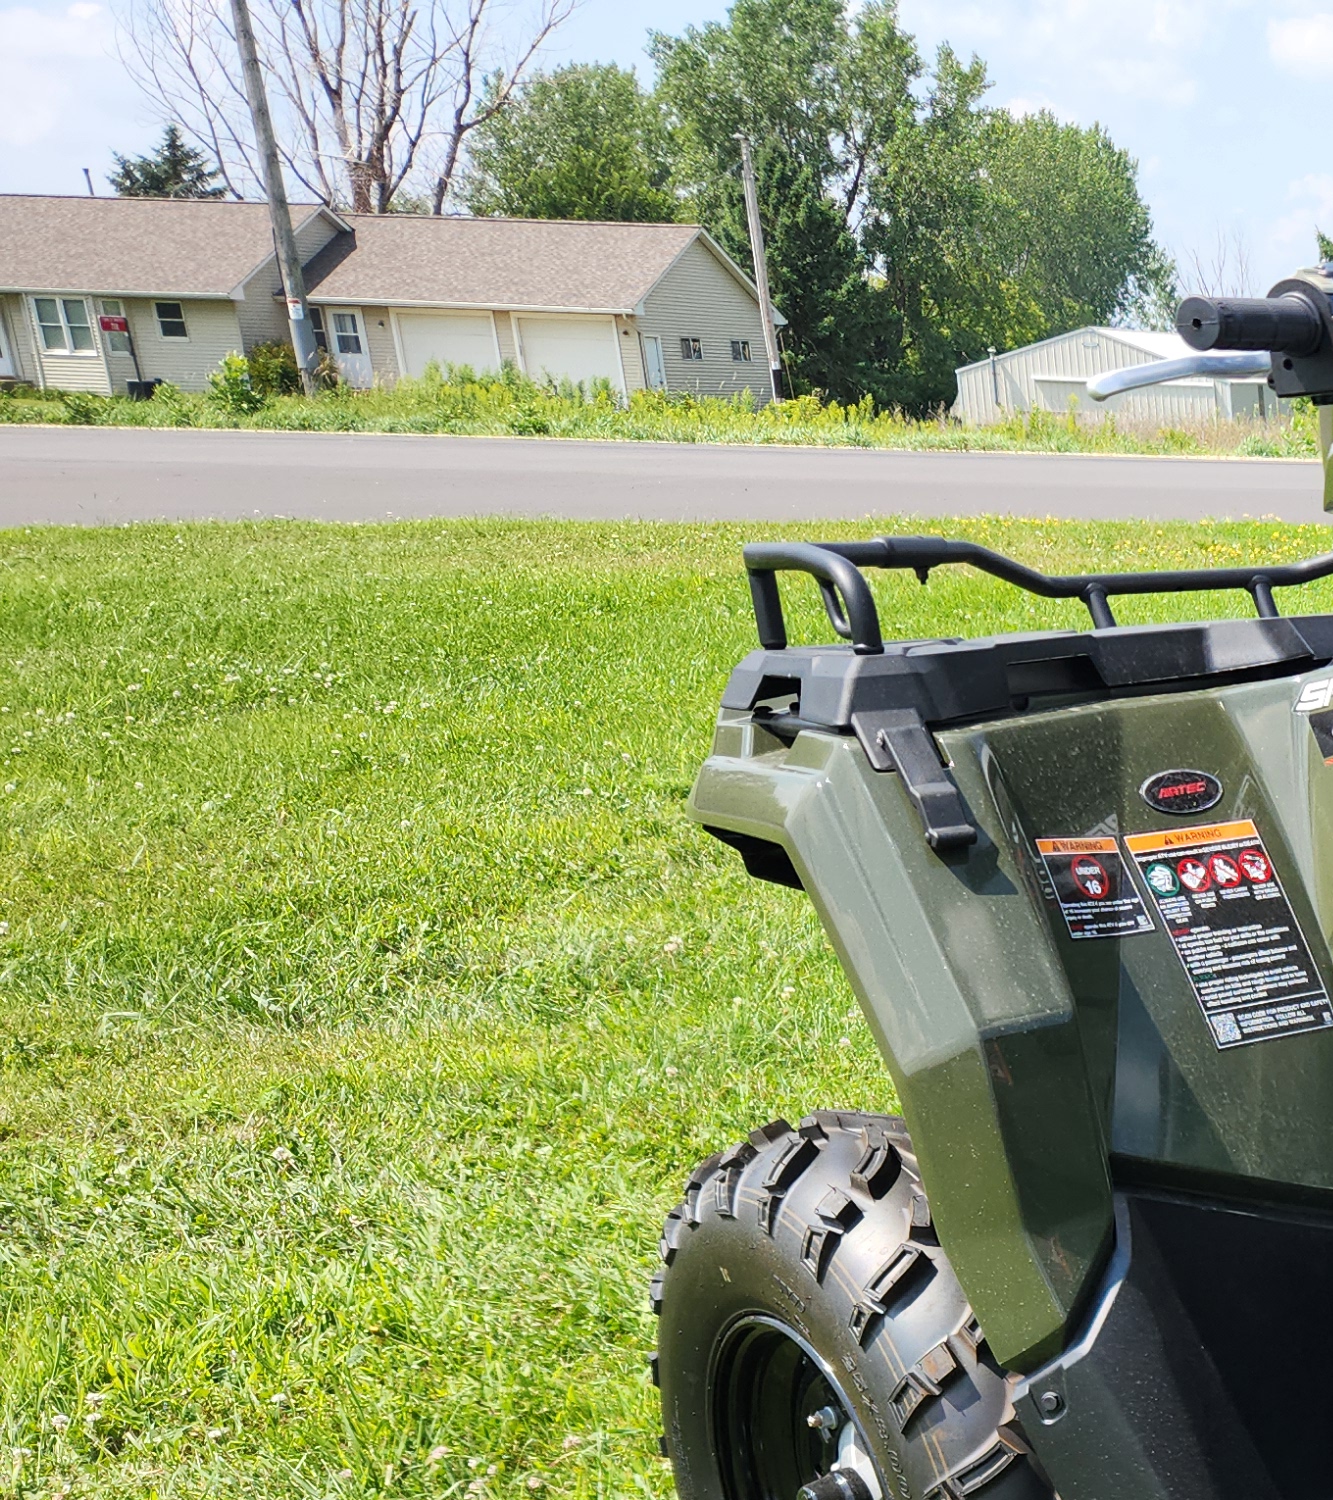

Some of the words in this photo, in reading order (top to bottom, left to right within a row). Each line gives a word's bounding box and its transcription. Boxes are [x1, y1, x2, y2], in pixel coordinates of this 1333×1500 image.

[1174, 828, 1221, 843] WARNING
[1060, 841, 1103, 850] WARNING
[1075, 866, 1101, 876] UNDER
[1085, 880, 1102, 894] 16
